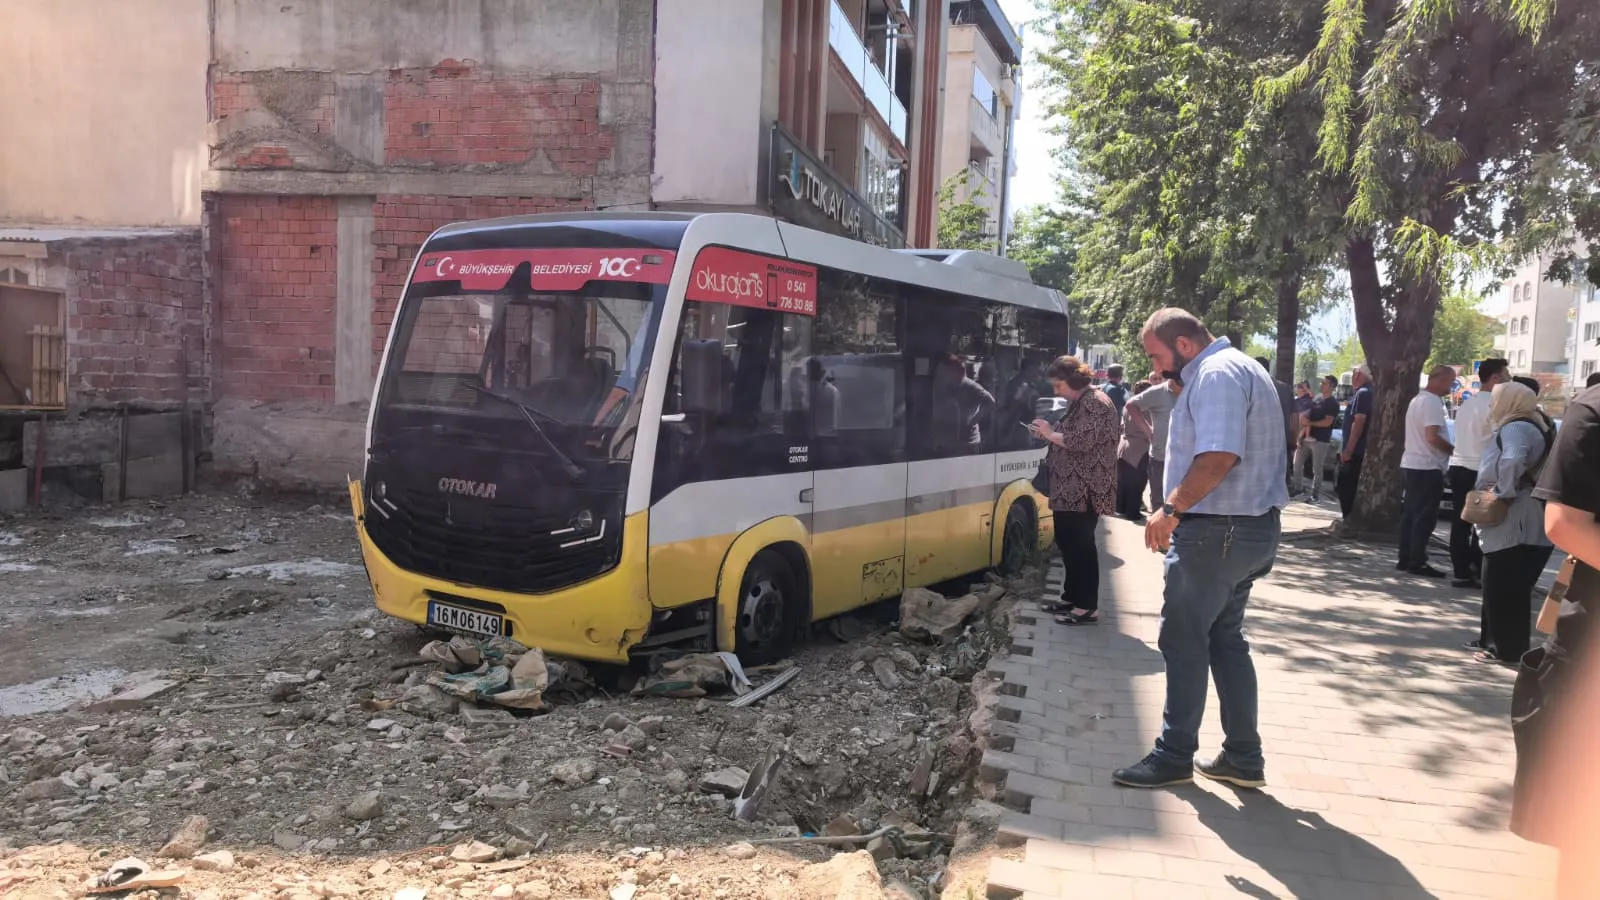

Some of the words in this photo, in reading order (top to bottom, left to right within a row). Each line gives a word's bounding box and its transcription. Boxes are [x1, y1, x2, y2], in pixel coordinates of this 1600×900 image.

[804, 166, 861, 237] TOKAYLAR
[459, 262, 515, 276] BÜYÜKŞEHİR
[532, 262, 593, 275] BELEDİYESİ
[696, 265, 764, 300] okurajans
[787, 280, 793, 290] 0
[438, 477, 496, 499] OTOKAR
